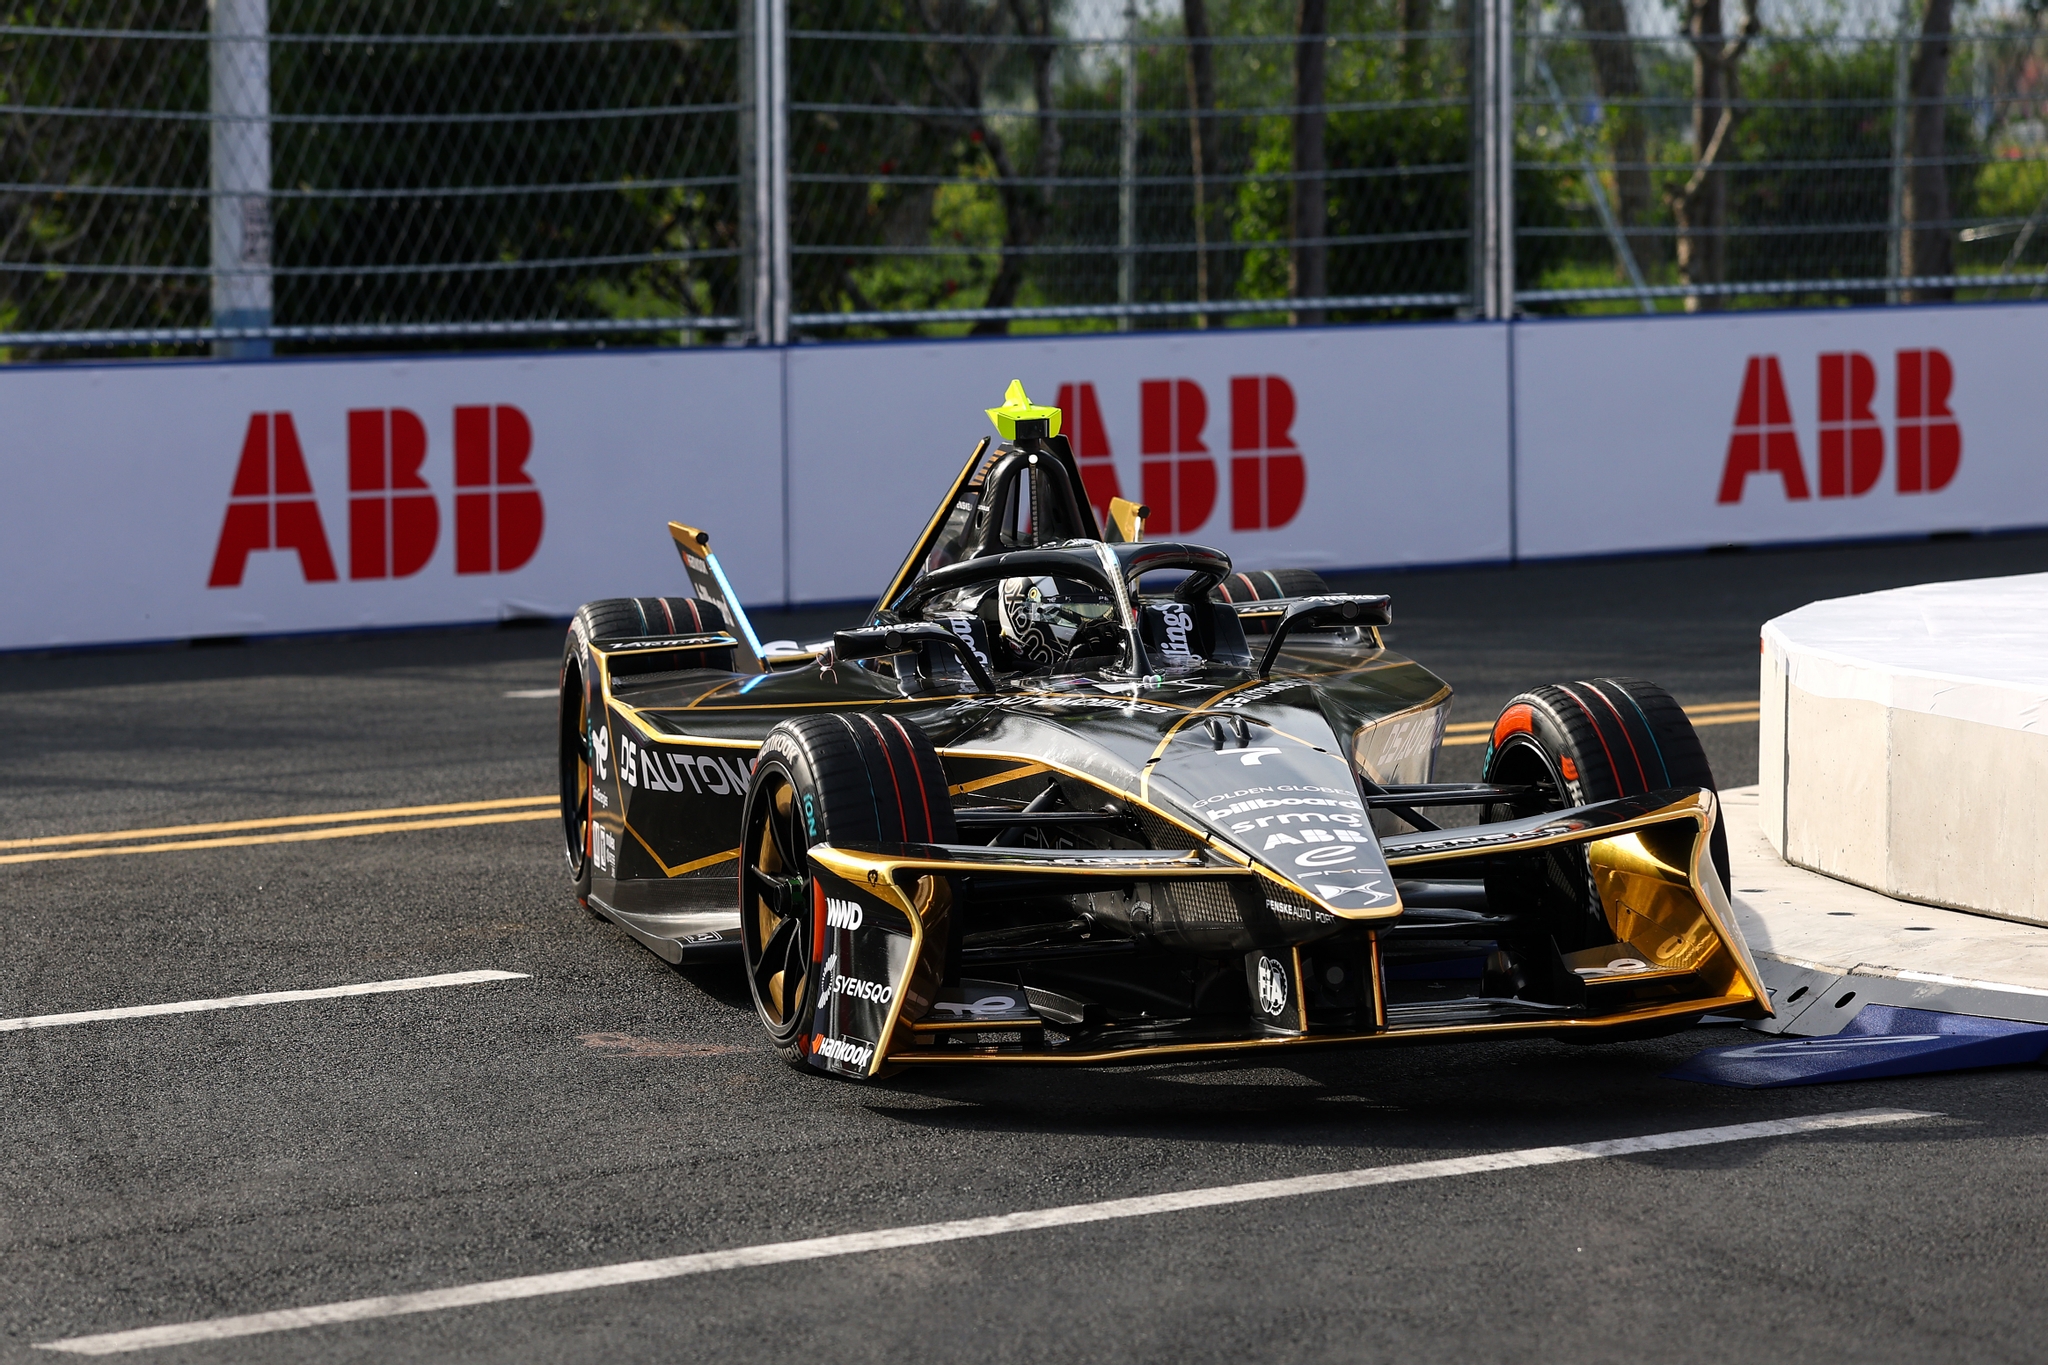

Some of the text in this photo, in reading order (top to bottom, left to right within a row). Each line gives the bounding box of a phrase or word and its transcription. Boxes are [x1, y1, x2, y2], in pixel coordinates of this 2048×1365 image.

[1716, 346, 1963, 506] ABB
[207, 403, 545, 589] ABB
[620, 733, 638, 788] DS
[640, 748, 759, 797] AUTOM
[1214, 746, 1282, 766] 7
[1192, 784, 1359, 809] GOLDEN GLOBES
[1205, 797, 1364, 822] billboard
[1231, 812, 1364, 834] srmg
[1263, 829, 1369, 851] ABB
[826, 897, 863, 931] WWD
[833, 975, 893, 1004] SYENSQO
[1259, 964, 1284, 1006] FIA
